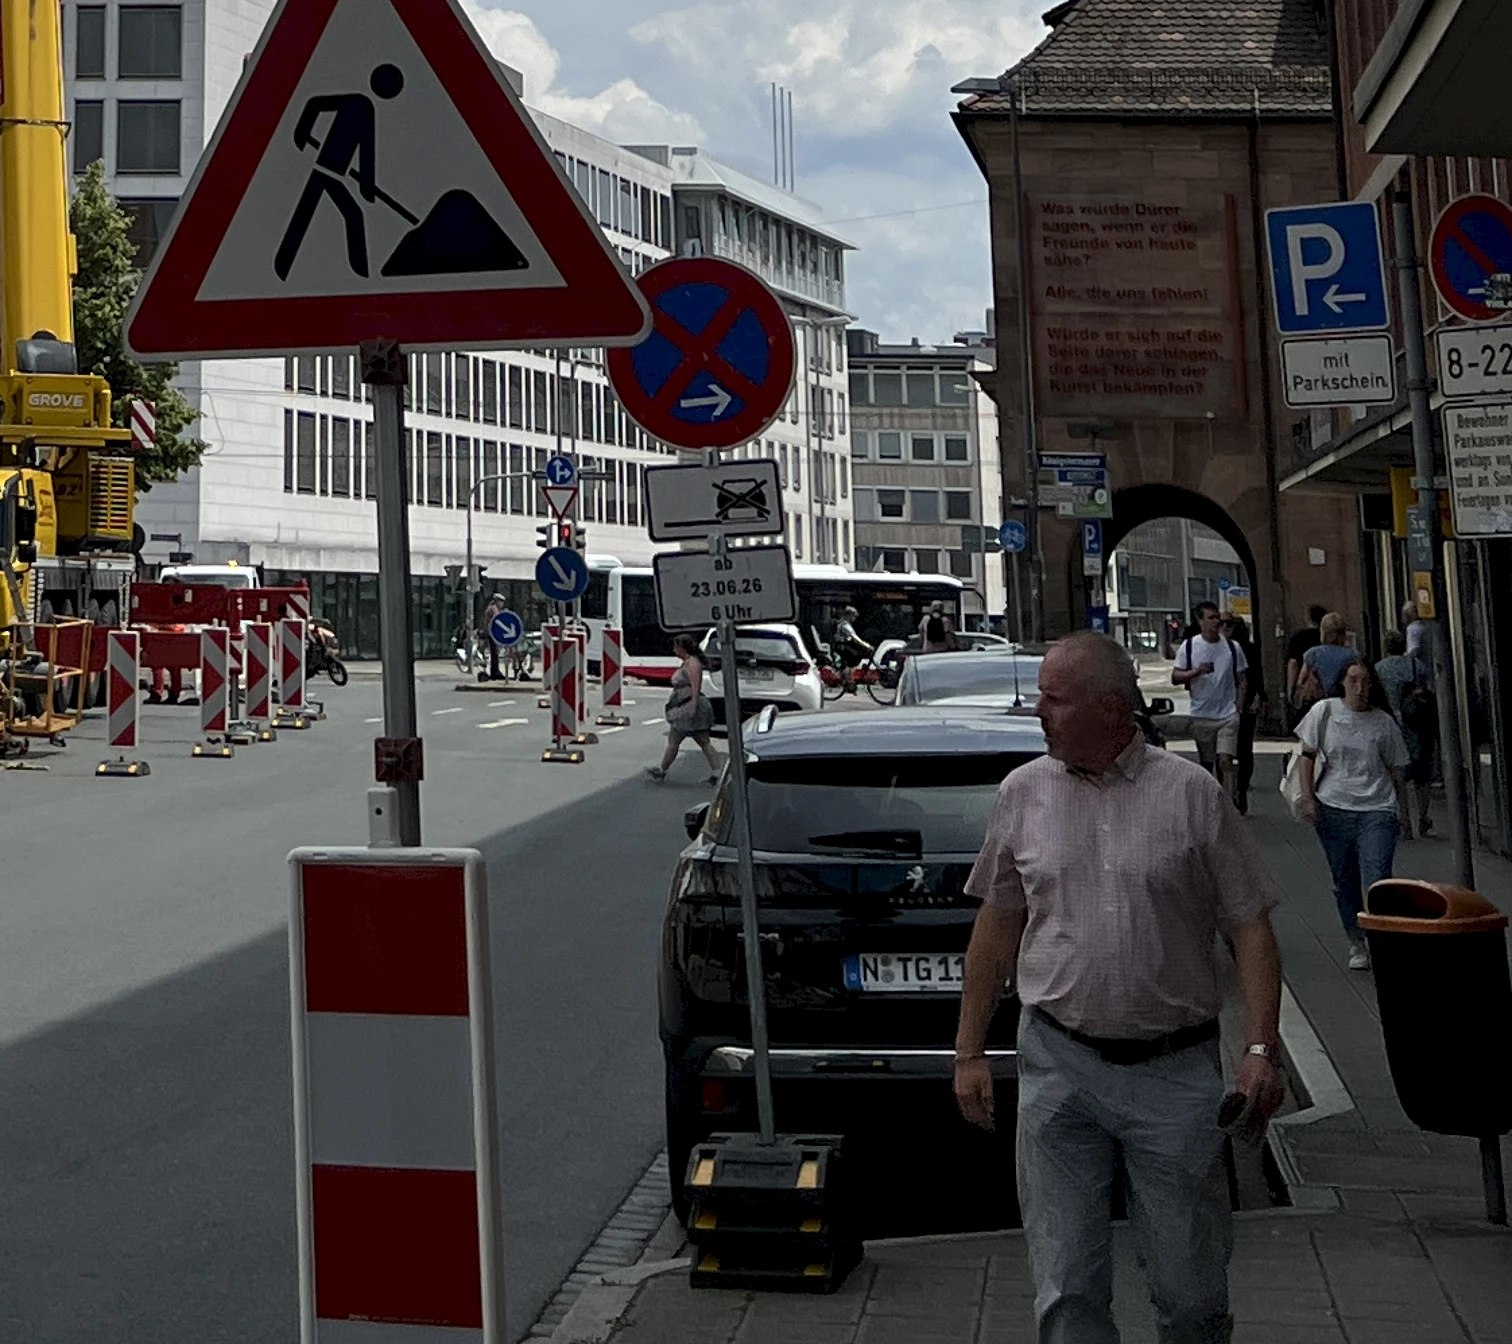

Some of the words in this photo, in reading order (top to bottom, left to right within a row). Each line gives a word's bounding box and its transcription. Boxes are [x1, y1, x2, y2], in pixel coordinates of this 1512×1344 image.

[1041, 202, 1075, 215] Was
[1042, 236, 1110, 250] Freunde
[1047, 327, 1100, 342] Würde
[1323, 351, 1351, 369] mit
[1293, 373, 1387, 392] Parkschein
[28, 393, 85, 408] GROVE
[714, 556, 733, 571] ab
[711, 605, 721, 620] 6
[724, 603, 753, 620] Uhr
[862, 958, 879, 982] N
[897, 957, 932, 982] TG
